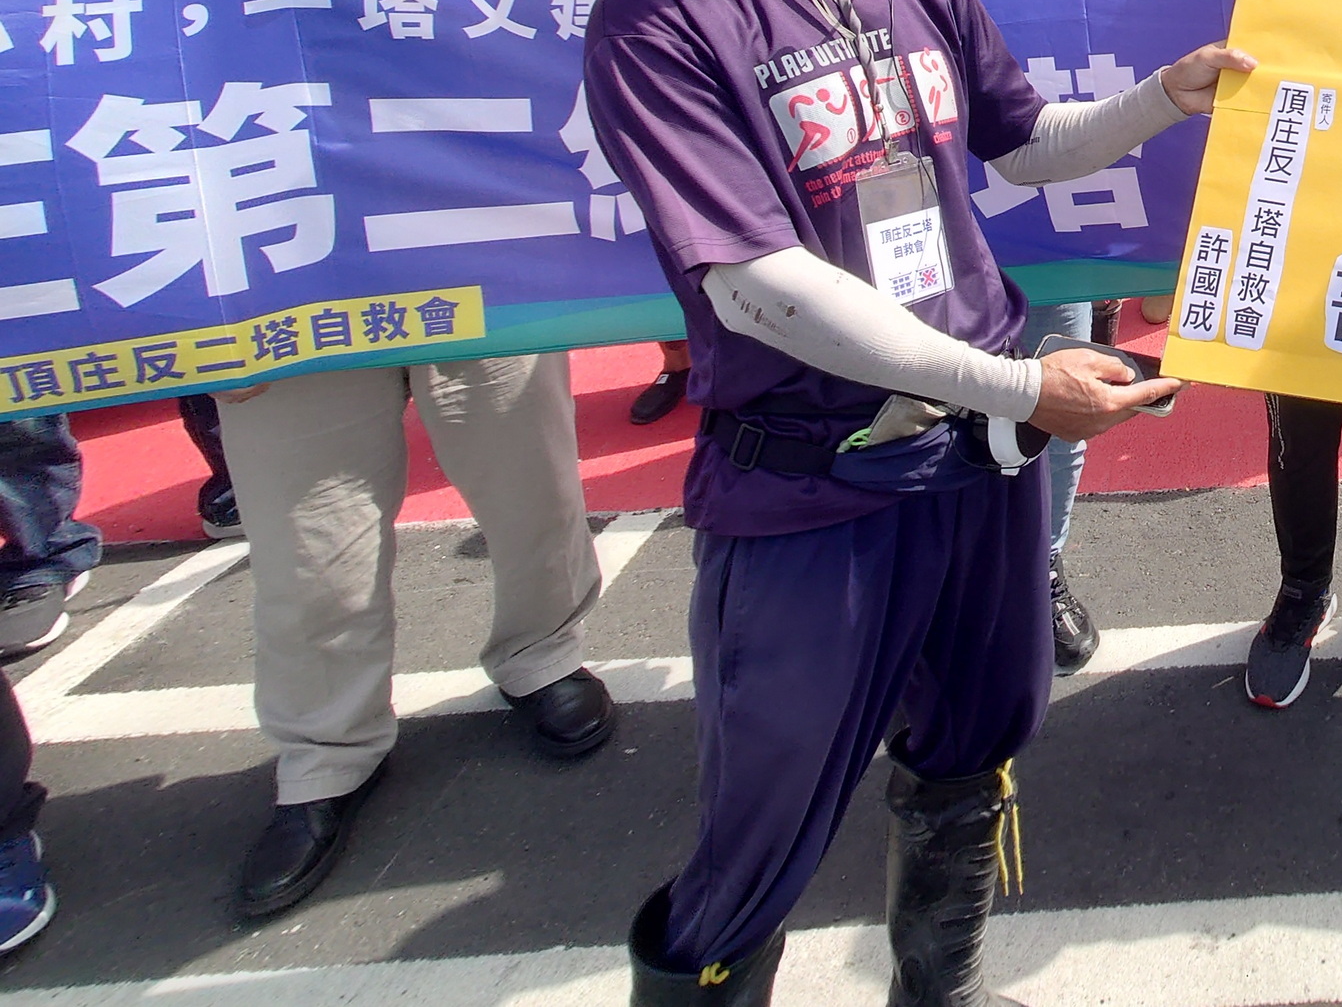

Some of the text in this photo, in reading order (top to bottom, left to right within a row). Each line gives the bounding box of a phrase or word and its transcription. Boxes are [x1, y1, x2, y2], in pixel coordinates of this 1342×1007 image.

[754, 49, 814, 90] PLAY
[1319, 92, 1333, 127] 寄件人
[0, 80, 648, 321] 第二
[880, 218, 933, 244] 頂庄反二塔
[1232, 86, 1309, 339] 頂庄反二塔自救會
[893, 240, 924, 259] 自救會
[1183, 232, 1229, 333] 許國成
[2, 295, 460, 405] 頂庄反二塔自救會
